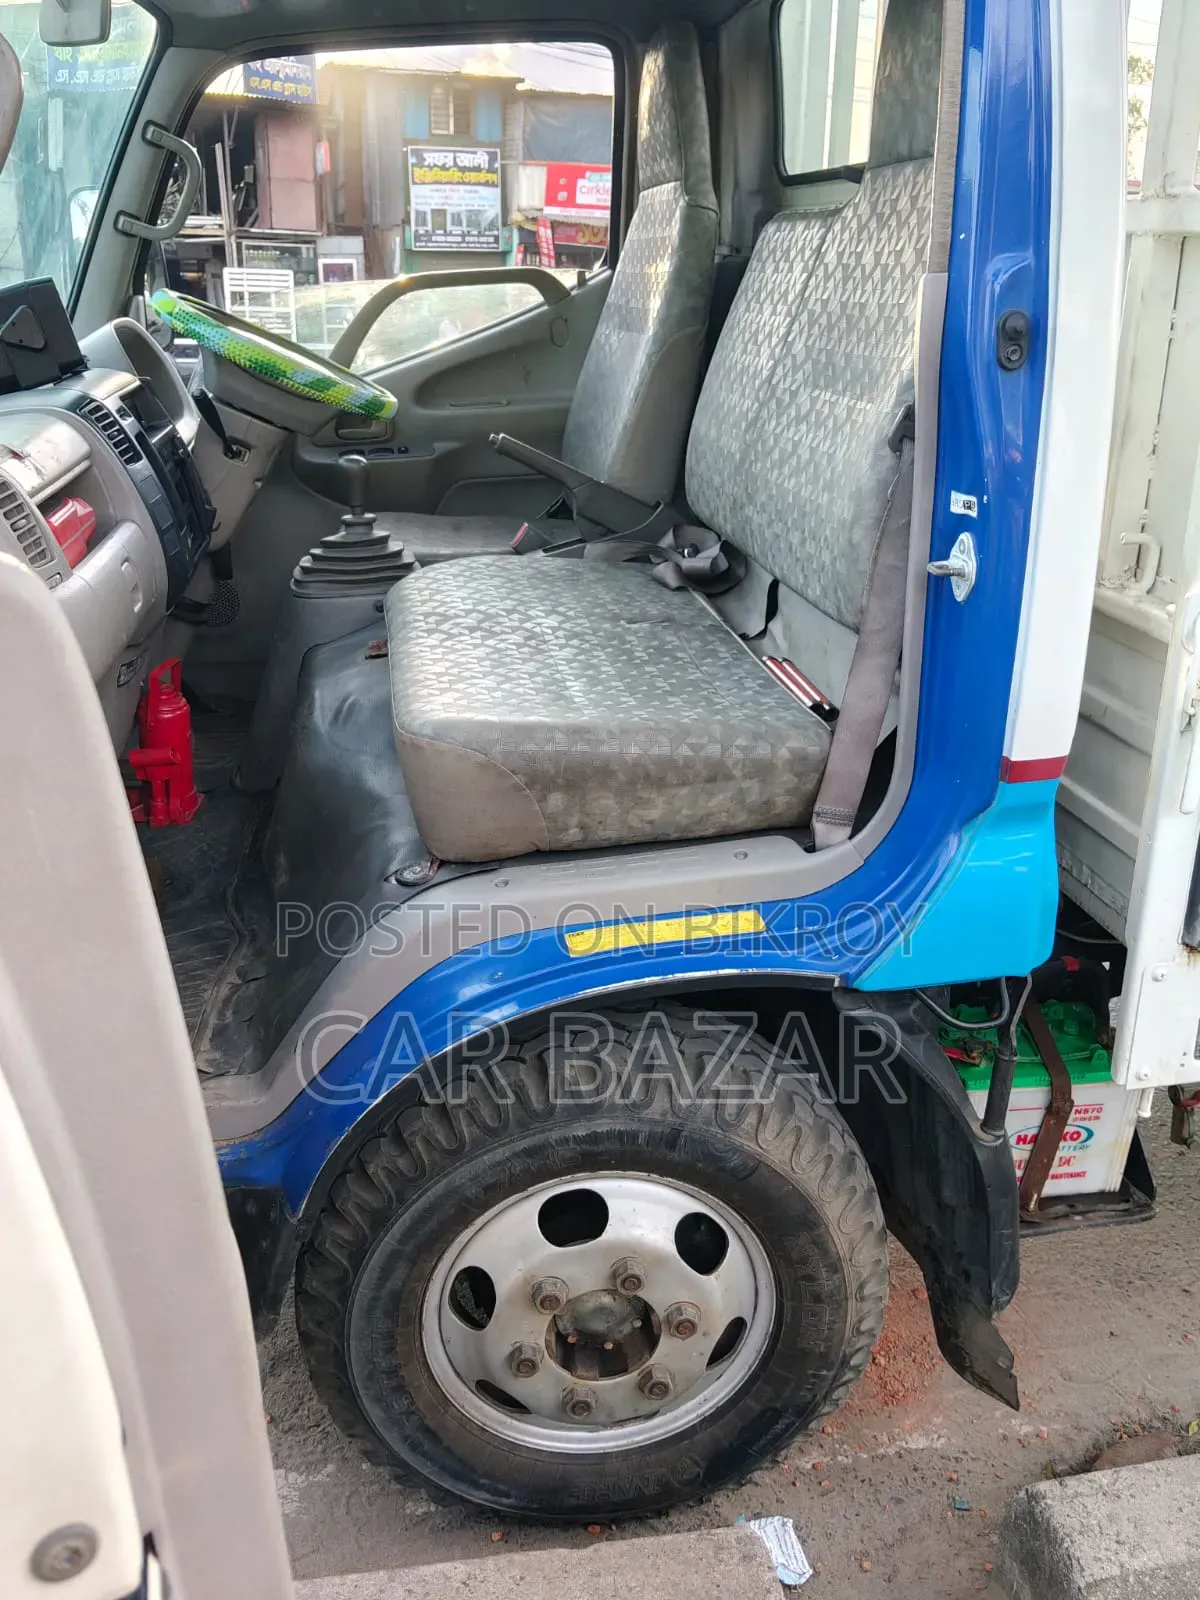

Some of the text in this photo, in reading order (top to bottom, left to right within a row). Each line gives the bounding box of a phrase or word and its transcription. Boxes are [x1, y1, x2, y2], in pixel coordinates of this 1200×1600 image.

[455, 151, 489, 169] আলী
[1074, 1107, 1103, 1115] NS70
[1015, 1130, 1082, 1146] HAKO
